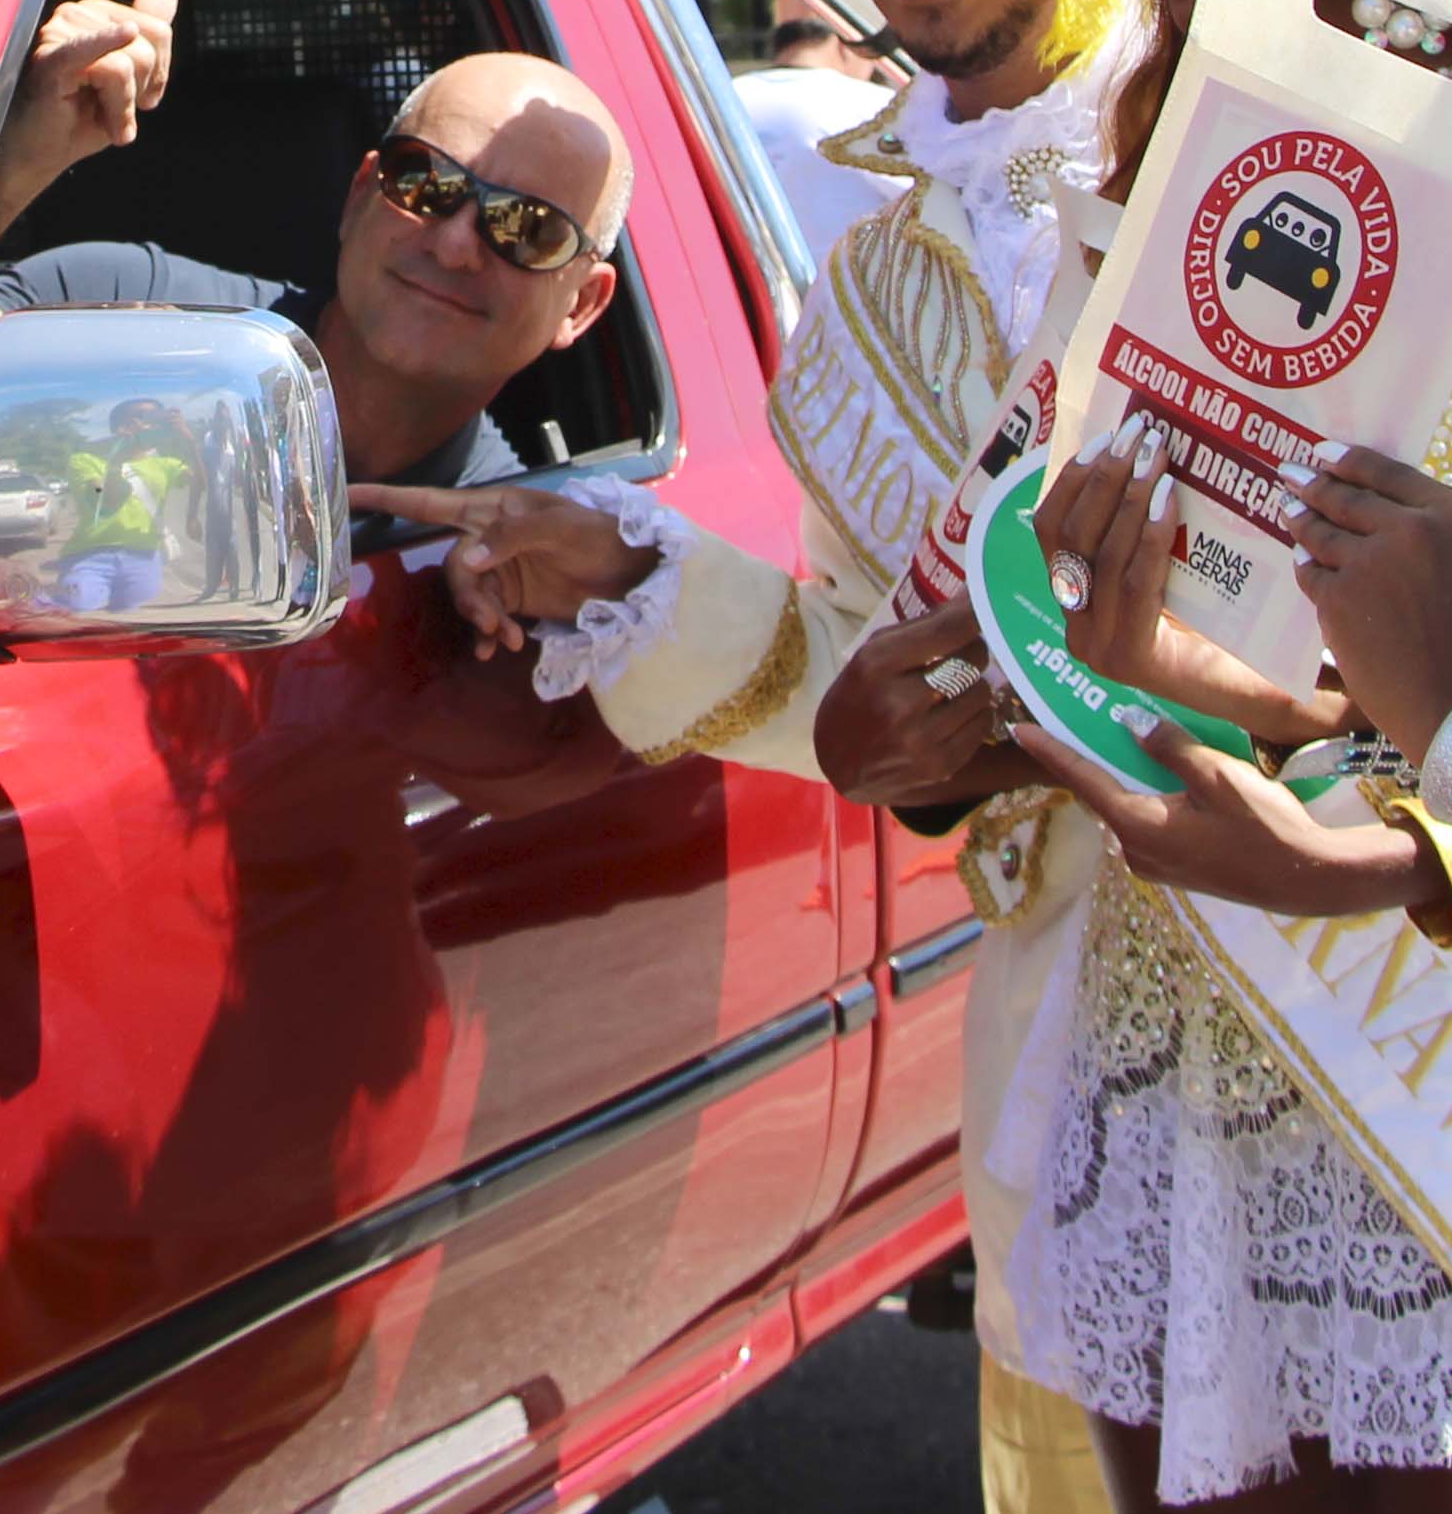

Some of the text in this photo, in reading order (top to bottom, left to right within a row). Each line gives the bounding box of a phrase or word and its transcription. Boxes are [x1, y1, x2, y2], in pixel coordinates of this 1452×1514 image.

[1221, 138, 1392, 279] SOU PELA VIDA
[1190, 209, 1378, 382] DIRIJO SEM BEBIDA
[1113, 338, 1188, 407] ÁLCOOL
[1188, 385, 1243, 433] NÃO
[1188, 551, 1245, 596] GERAIS
[1193, 531, 1252, 579] MINAS
[1025, 639, 1108, 712] Dirigir
